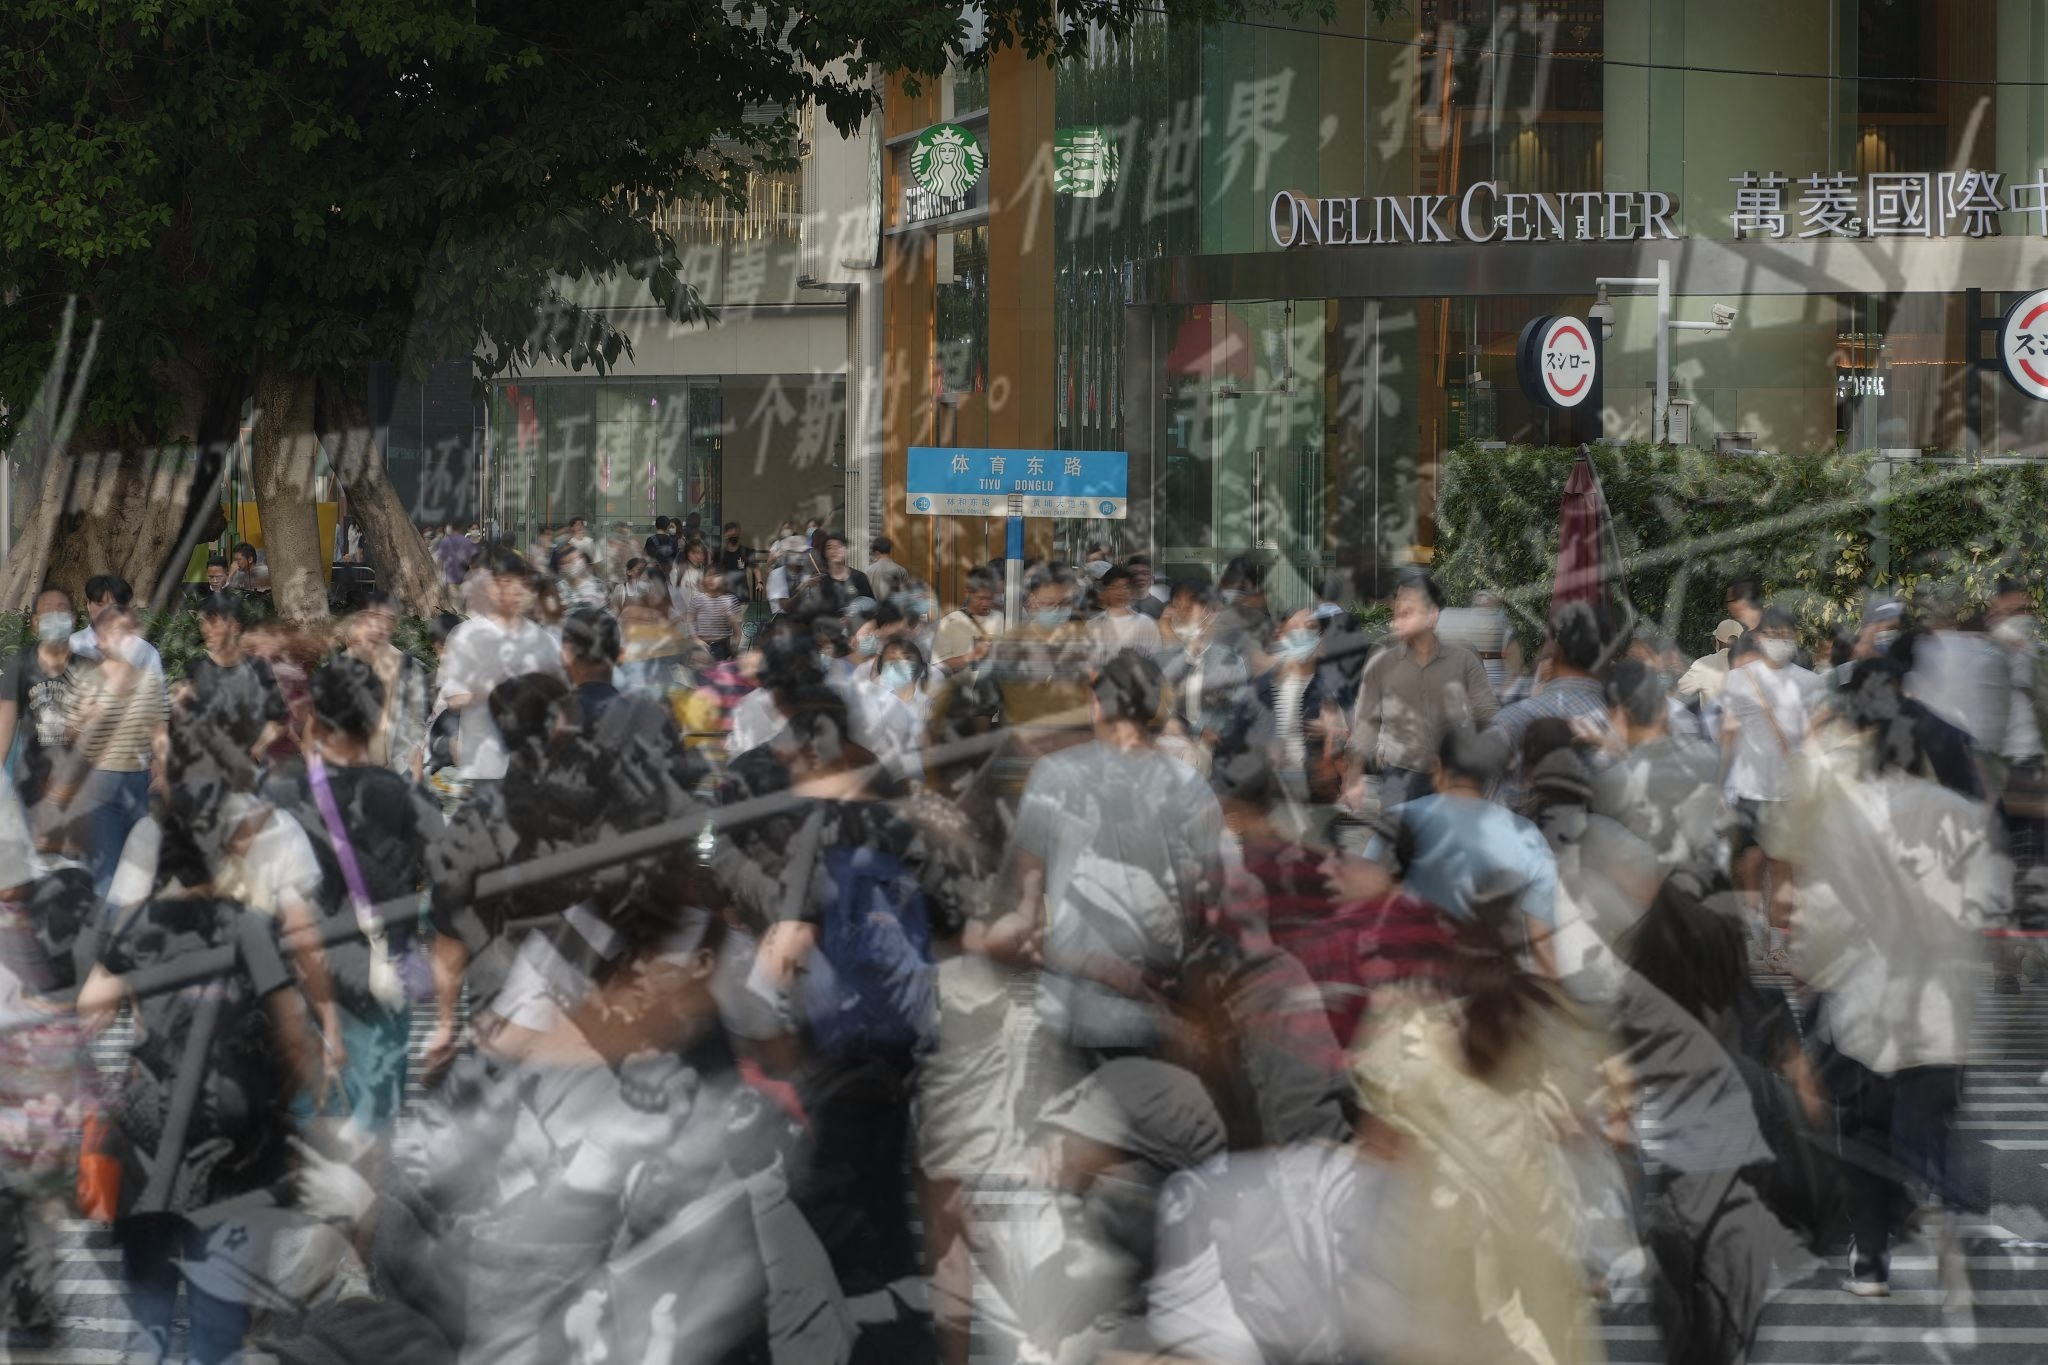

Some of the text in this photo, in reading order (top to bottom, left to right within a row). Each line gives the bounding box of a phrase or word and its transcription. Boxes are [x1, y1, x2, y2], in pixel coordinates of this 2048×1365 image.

[1269, 190, 1450, 247] ONELINK
[1461, 180, 1681, 243] CENTER
[1545, 352, 1591, 370] スシロー
[952, 454, 1082, 477] 体育东路
[979, 478, 1053, 491] TIYU DONGLU
